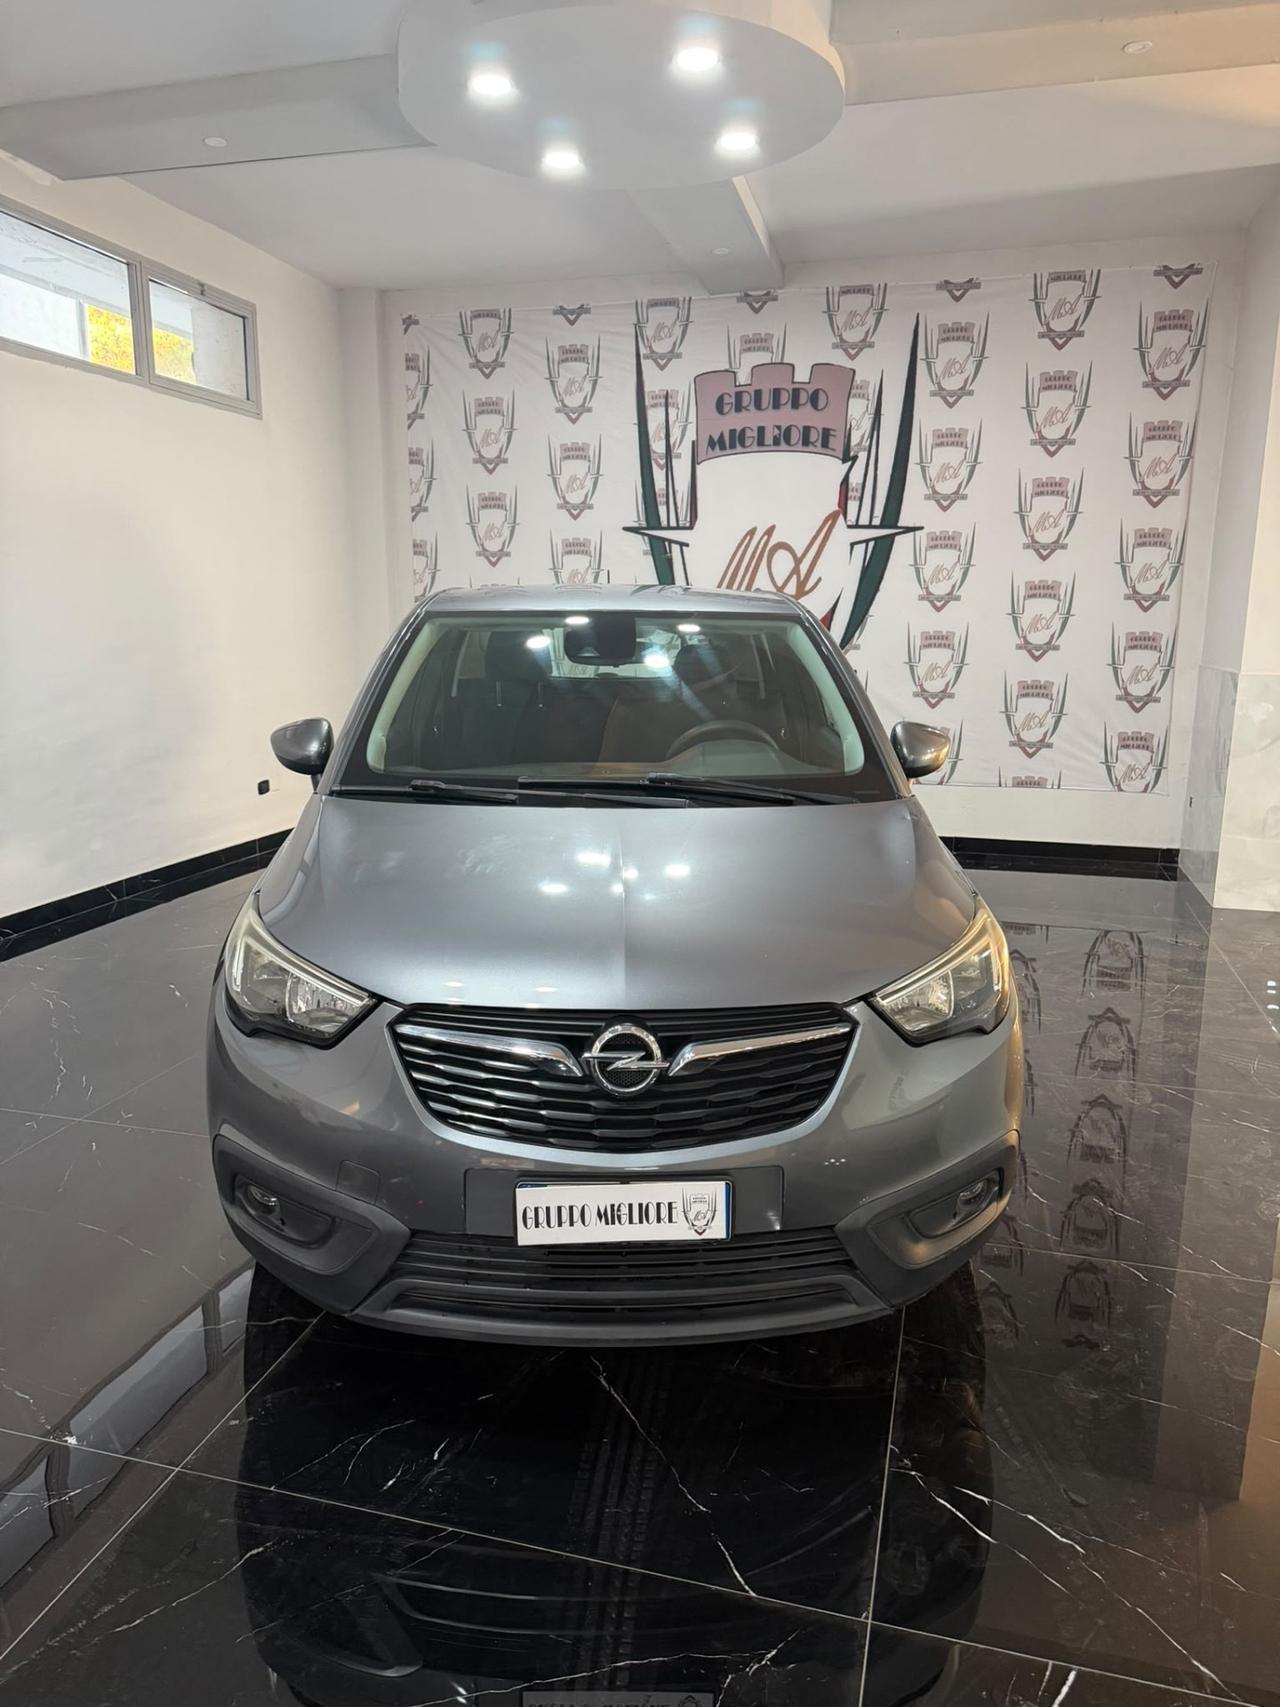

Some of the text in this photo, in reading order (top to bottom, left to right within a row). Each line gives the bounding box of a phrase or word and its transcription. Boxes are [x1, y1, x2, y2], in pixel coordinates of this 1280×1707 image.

[715, 388, 829, 416] GRUPPO
[706, 424, 837, 455] MIGLIORE
[522, 1201, 678, 1230] GRUPPO MIGLIORE
